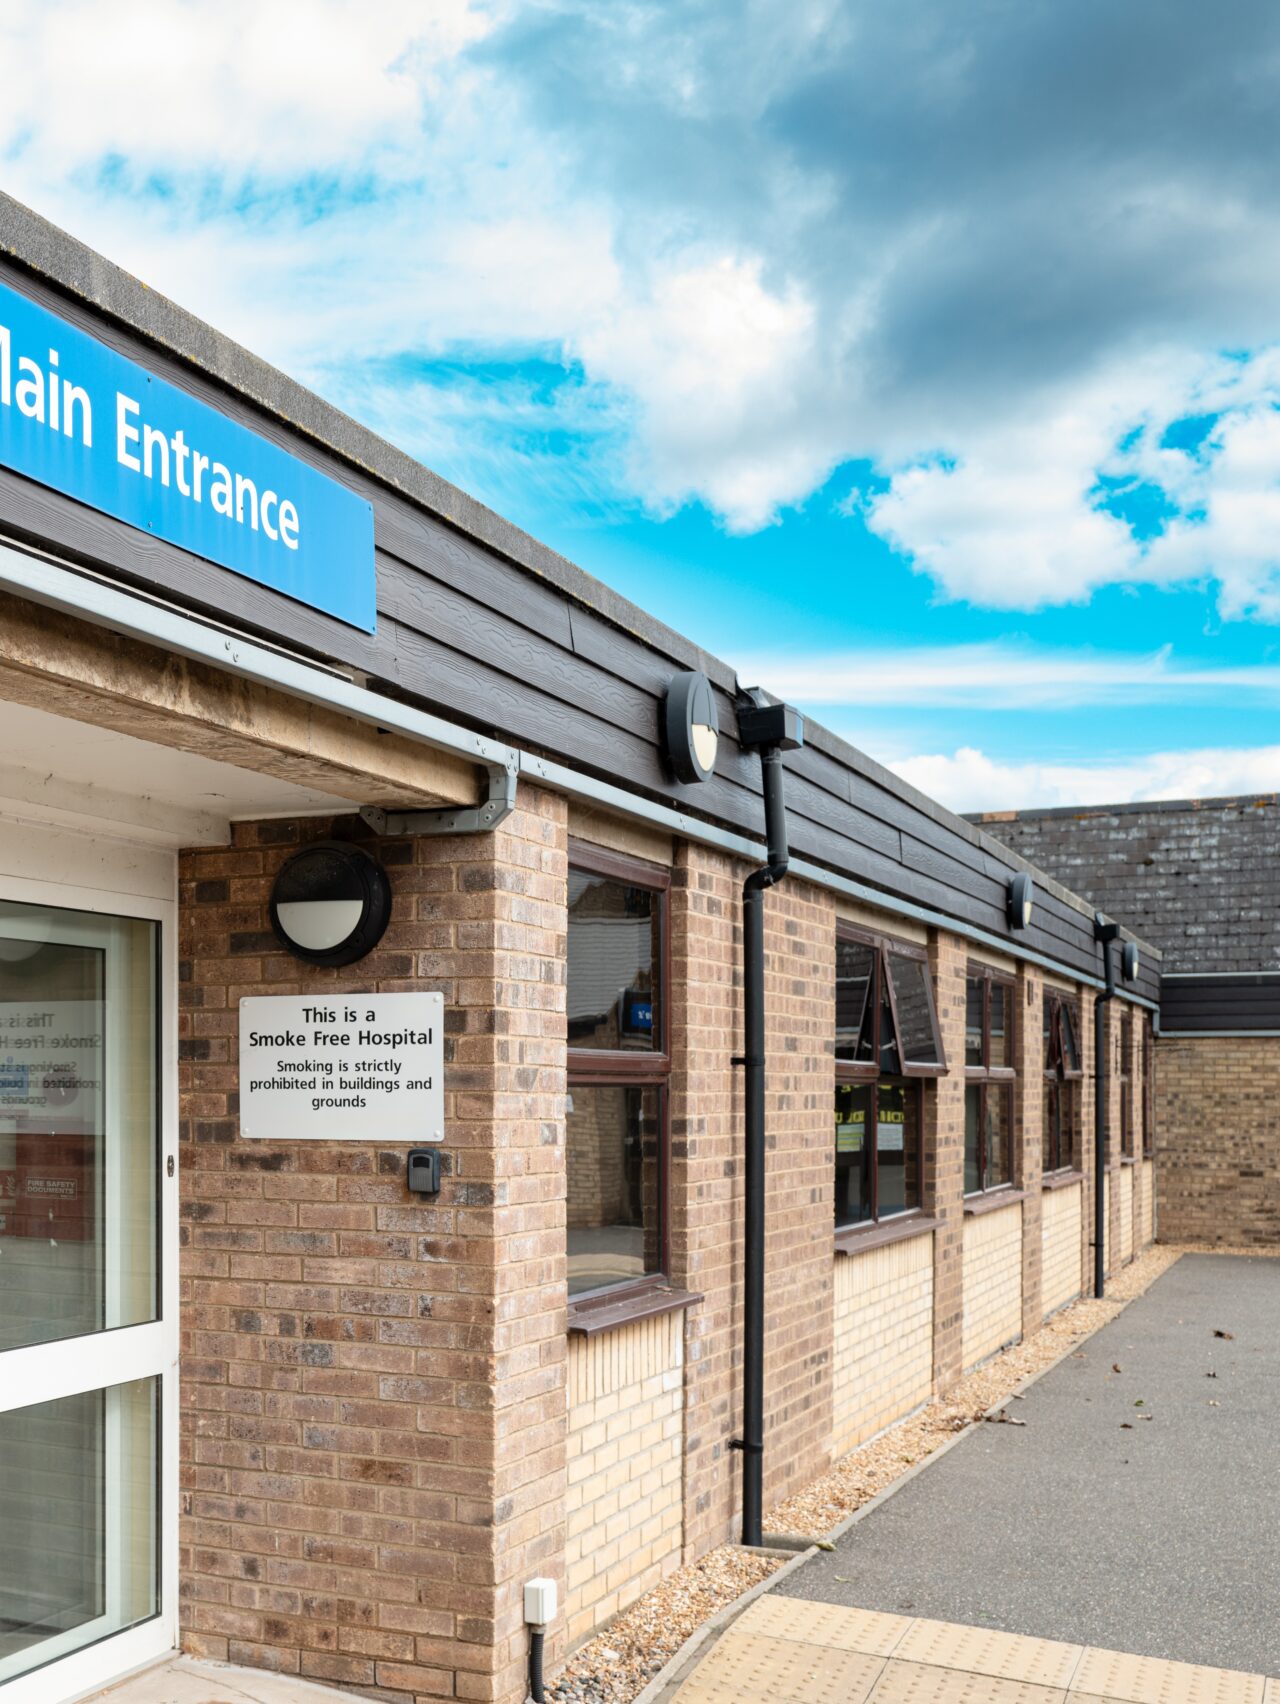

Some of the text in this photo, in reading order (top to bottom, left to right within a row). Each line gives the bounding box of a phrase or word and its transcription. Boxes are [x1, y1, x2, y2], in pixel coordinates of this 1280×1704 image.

[116, 391, 300, 551] Entrance
[302, 1006, 376, 1023] This is a
[249, 1028, 433, 1049] Smoke Free Hospital
[276, 1059, 402, 1075] Smoking is strictly
[249, 1076, 432, 1092] prohibited in buildings and
[311, 1094, 367, 1110] grounds
[27, 1179, 75, 1188] FIRE SAFETY
[27, 1186, 74, 1195] DOCUMENTS
